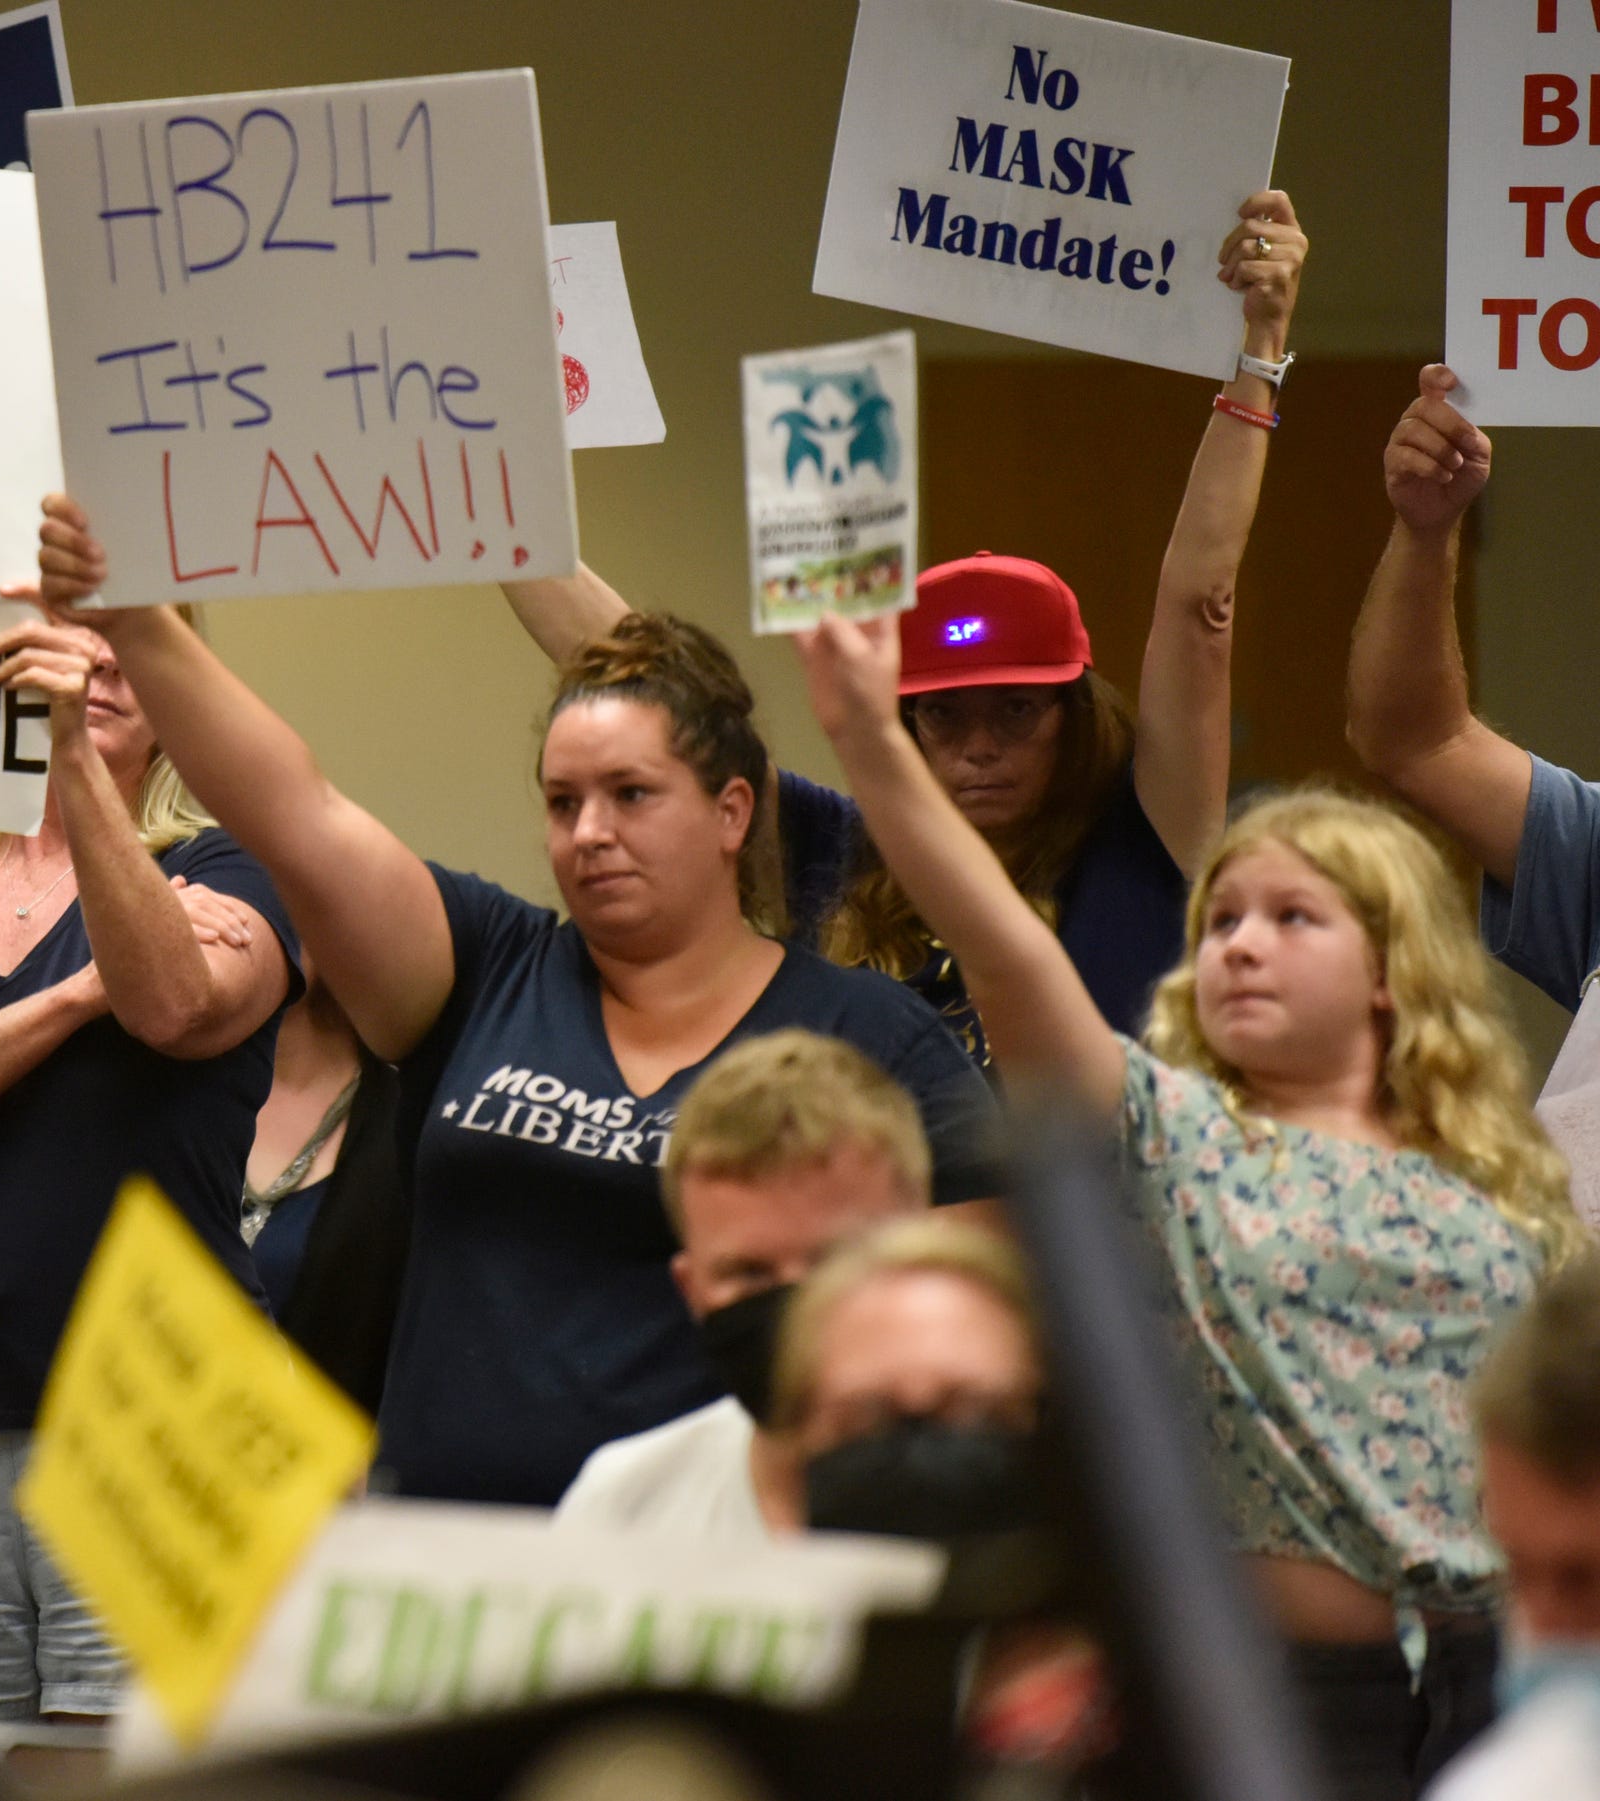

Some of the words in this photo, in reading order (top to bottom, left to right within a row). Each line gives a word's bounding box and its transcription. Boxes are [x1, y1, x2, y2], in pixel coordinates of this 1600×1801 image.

[1004, 45, 1080, 111] No
[1522, 73, 1600, 146] B
[95, 100, 479, 294] HB241
[949, 116, 1135, 206] MASK
[890, 186, 1176, 296] Mandate!
[97, 336, 272, 433] It's
[325, 325, 496, 433] the
[162, 437, 530, 583] LAW!!
[457, 1092, 673, 1168] LIBERT
[482, 1063, 636, 1129] MOMS
